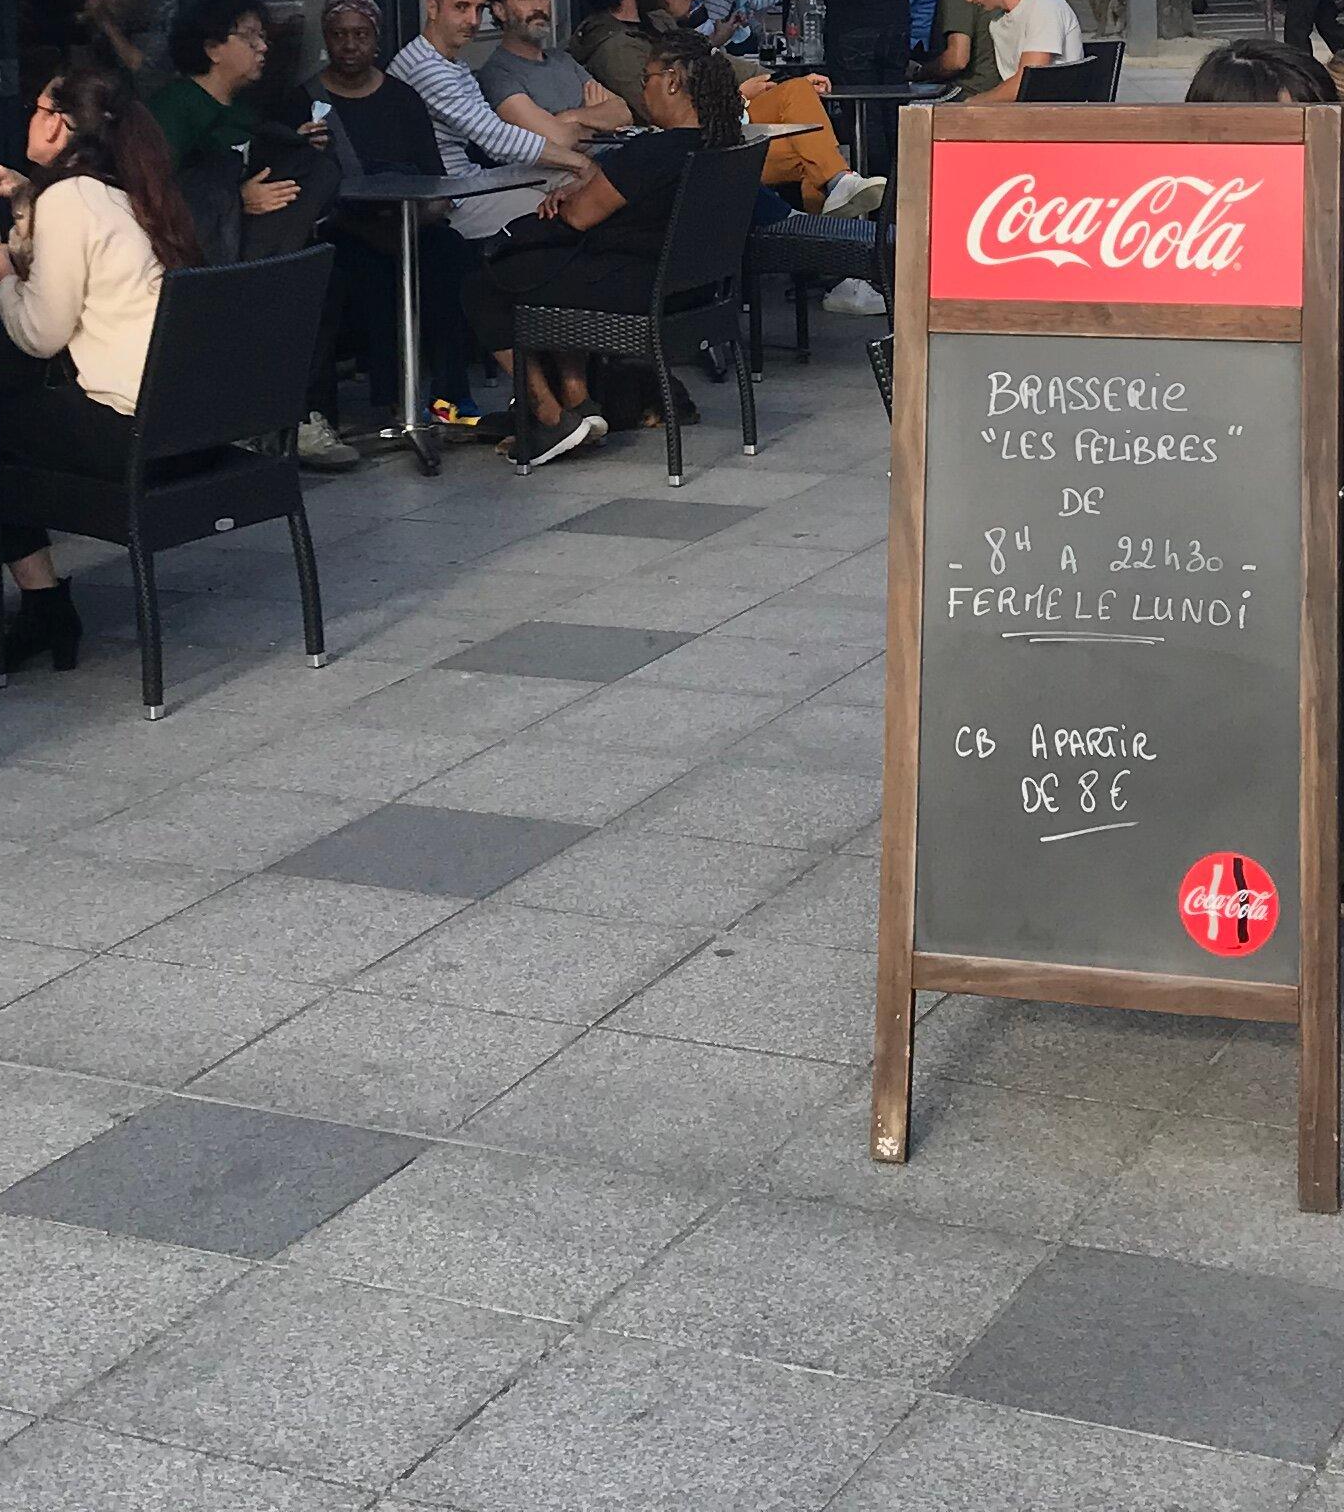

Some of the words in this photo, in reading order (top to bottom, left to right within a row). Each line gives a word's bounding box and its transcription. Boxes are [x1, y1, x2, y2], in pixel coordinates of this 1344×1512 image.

[966, 173, 1264, 271] Coca-Cola
[1058, 486, 1105, 517] DE
[1060, 544, 1078, 575] A
[1109, 535, 1225, 573] 22h30
[1074, 589, 1117, 621] LE
[955, 725, 997, 760] CB
[1021, 773, 1059, 813] DE
